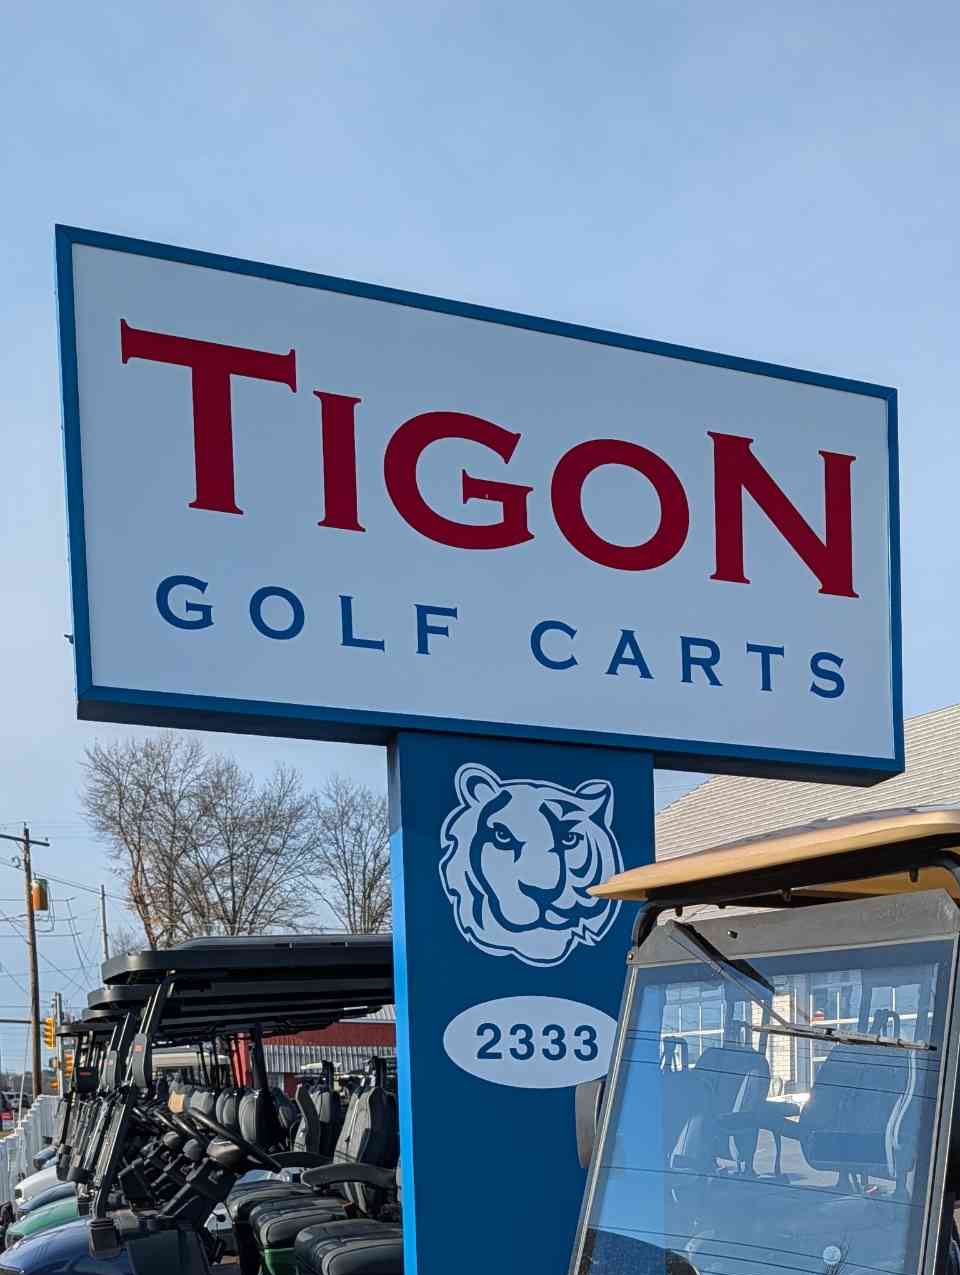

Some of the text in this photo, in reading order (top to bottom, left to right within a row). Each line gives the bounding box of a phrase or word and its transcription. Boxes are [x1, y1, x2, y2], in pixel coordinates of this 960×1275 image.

[121, 319, 859, 599] TIGON
[155, 574, 846, 699] GOLF CARTS
[476, 1022, 599, 1061] 2333
